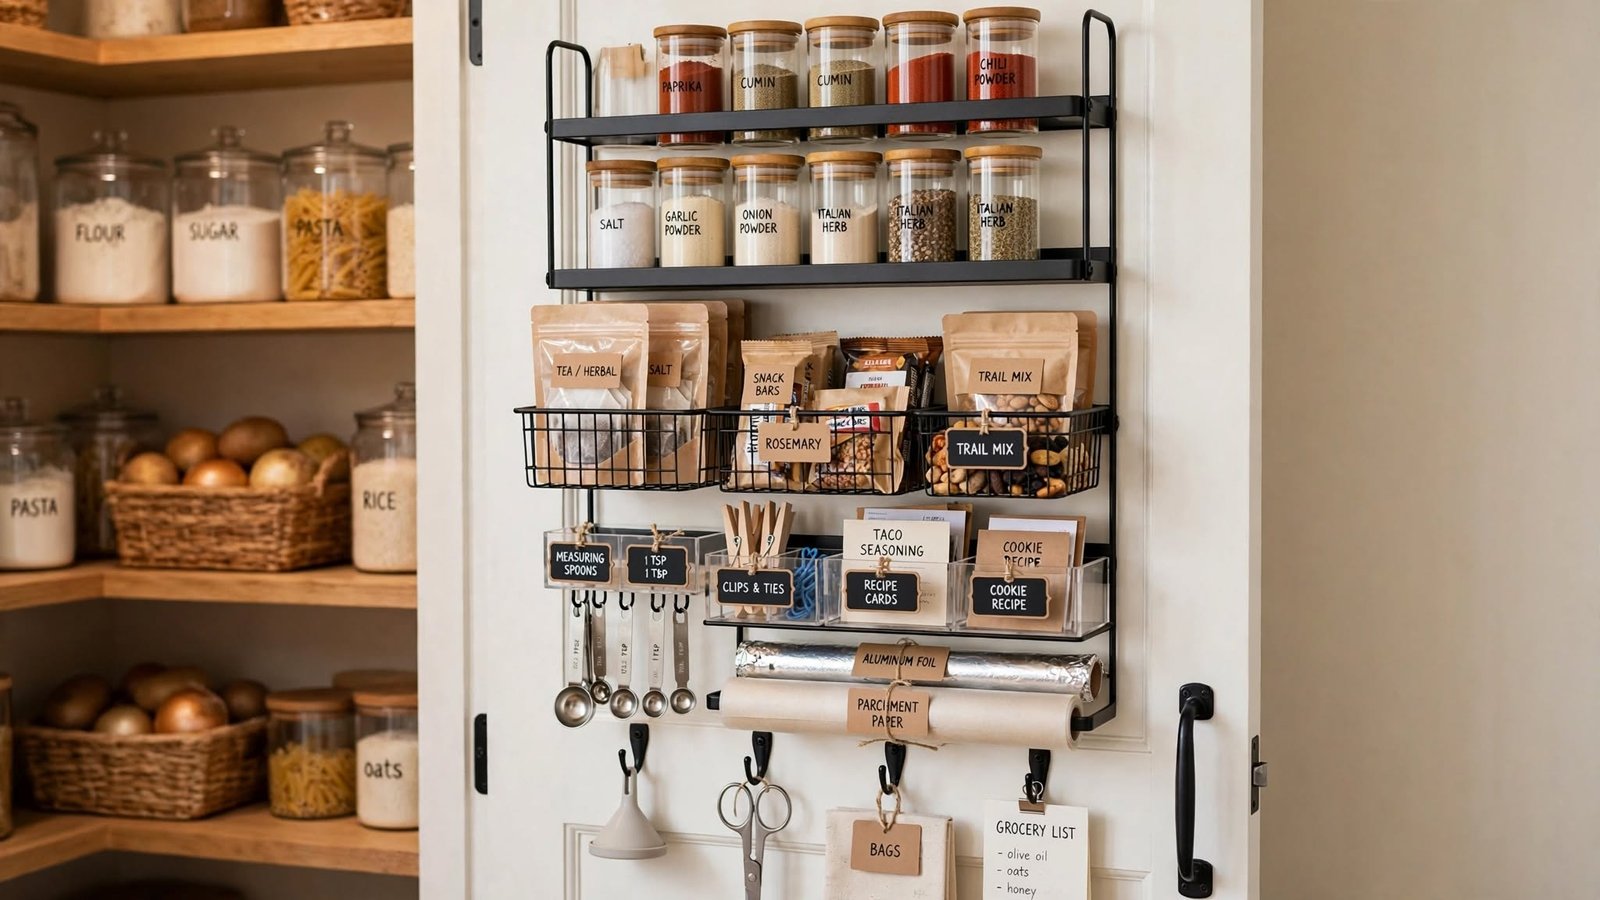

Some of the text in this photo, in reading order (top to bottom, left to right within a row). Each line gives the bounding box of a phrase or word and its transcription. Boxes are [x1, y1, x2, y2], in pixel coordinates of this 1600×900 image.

[979, 57, 1007, 71] CHILI
[740, 77, 776, 89] CUMIN
[817, 74, 852, 87] CUMIN
[974, 72, 1016, 86] POWDER
[662, 80, 702, 93] PAPRIKA
[742, 208, 773, 221] ONION
[818, 208, 852, 220] ITALIAN
[897, 204, 934, 217] ITALIAN
[976, 202, 1013, 215] ITALIAN
[665, 209, 698, 223] GARLIC
[979, 215, 1007, 228] HERB
[296, 217, 345, 238] PASTA
[599, 218, 625, 230] SALT
[664, 223, 701, 237] POWDER
[739, 222, 778, 235] POWDER
[822, 221, 848, 233] HERB
[900, 218, 926, 230] HERB
[76, 223, 127, 243] FLOUR
[189, 221, 240, 242] SUGAR
[556, 364, 617, 377] TEA / HERBAL
[649, 364, 673, 375] SALT
[753, 372, 785, 384] SNACK
[978, 371, 1032, 383] TRAIL MIX
[755, 385, 780, 397] BARS
[765, 437, 822, 451] ROSEMARY
[956, 442, 1014, 456] TRAIL MIX
[11, 497, 58, 518] PASTA
[363, 490, 397, 512] RICE
[873, 528, 903, 541] TACO
[860, 544, 924, 558] SEASONING
[1003, 541, 1043, 554] COOKIE
[556, 551, 605, 564] MEASURING
[644, 554, 667, 566] 1 TSP
[564, 565, 598, 577] SPOONS
[645, 568, 649, 579] 1
[722, 581, 785, 594] CLIPS & TIES
[864, 579, 898, 592] RECIPE
[990, 584, 1027, 597] COOKIE
[865, 593, 898, 605] CARDS
[991, 598, 1027, 611] RECIPE
[862, 653, 936, 668] ALUMINUM FOIL
[872, 714, 903, 729] PAPER
[364, 758, 403, 780] oats
[996, 820, 1076, 840] GROCERY LIST
[870, 842, 901, 858] BAGS
[1007, 848, 1030, 861] olive
[1035, 850, 1048, 862] oil
[1006, 866, 1029, 878] oats
[1007, 882, 1037, 900] honey
